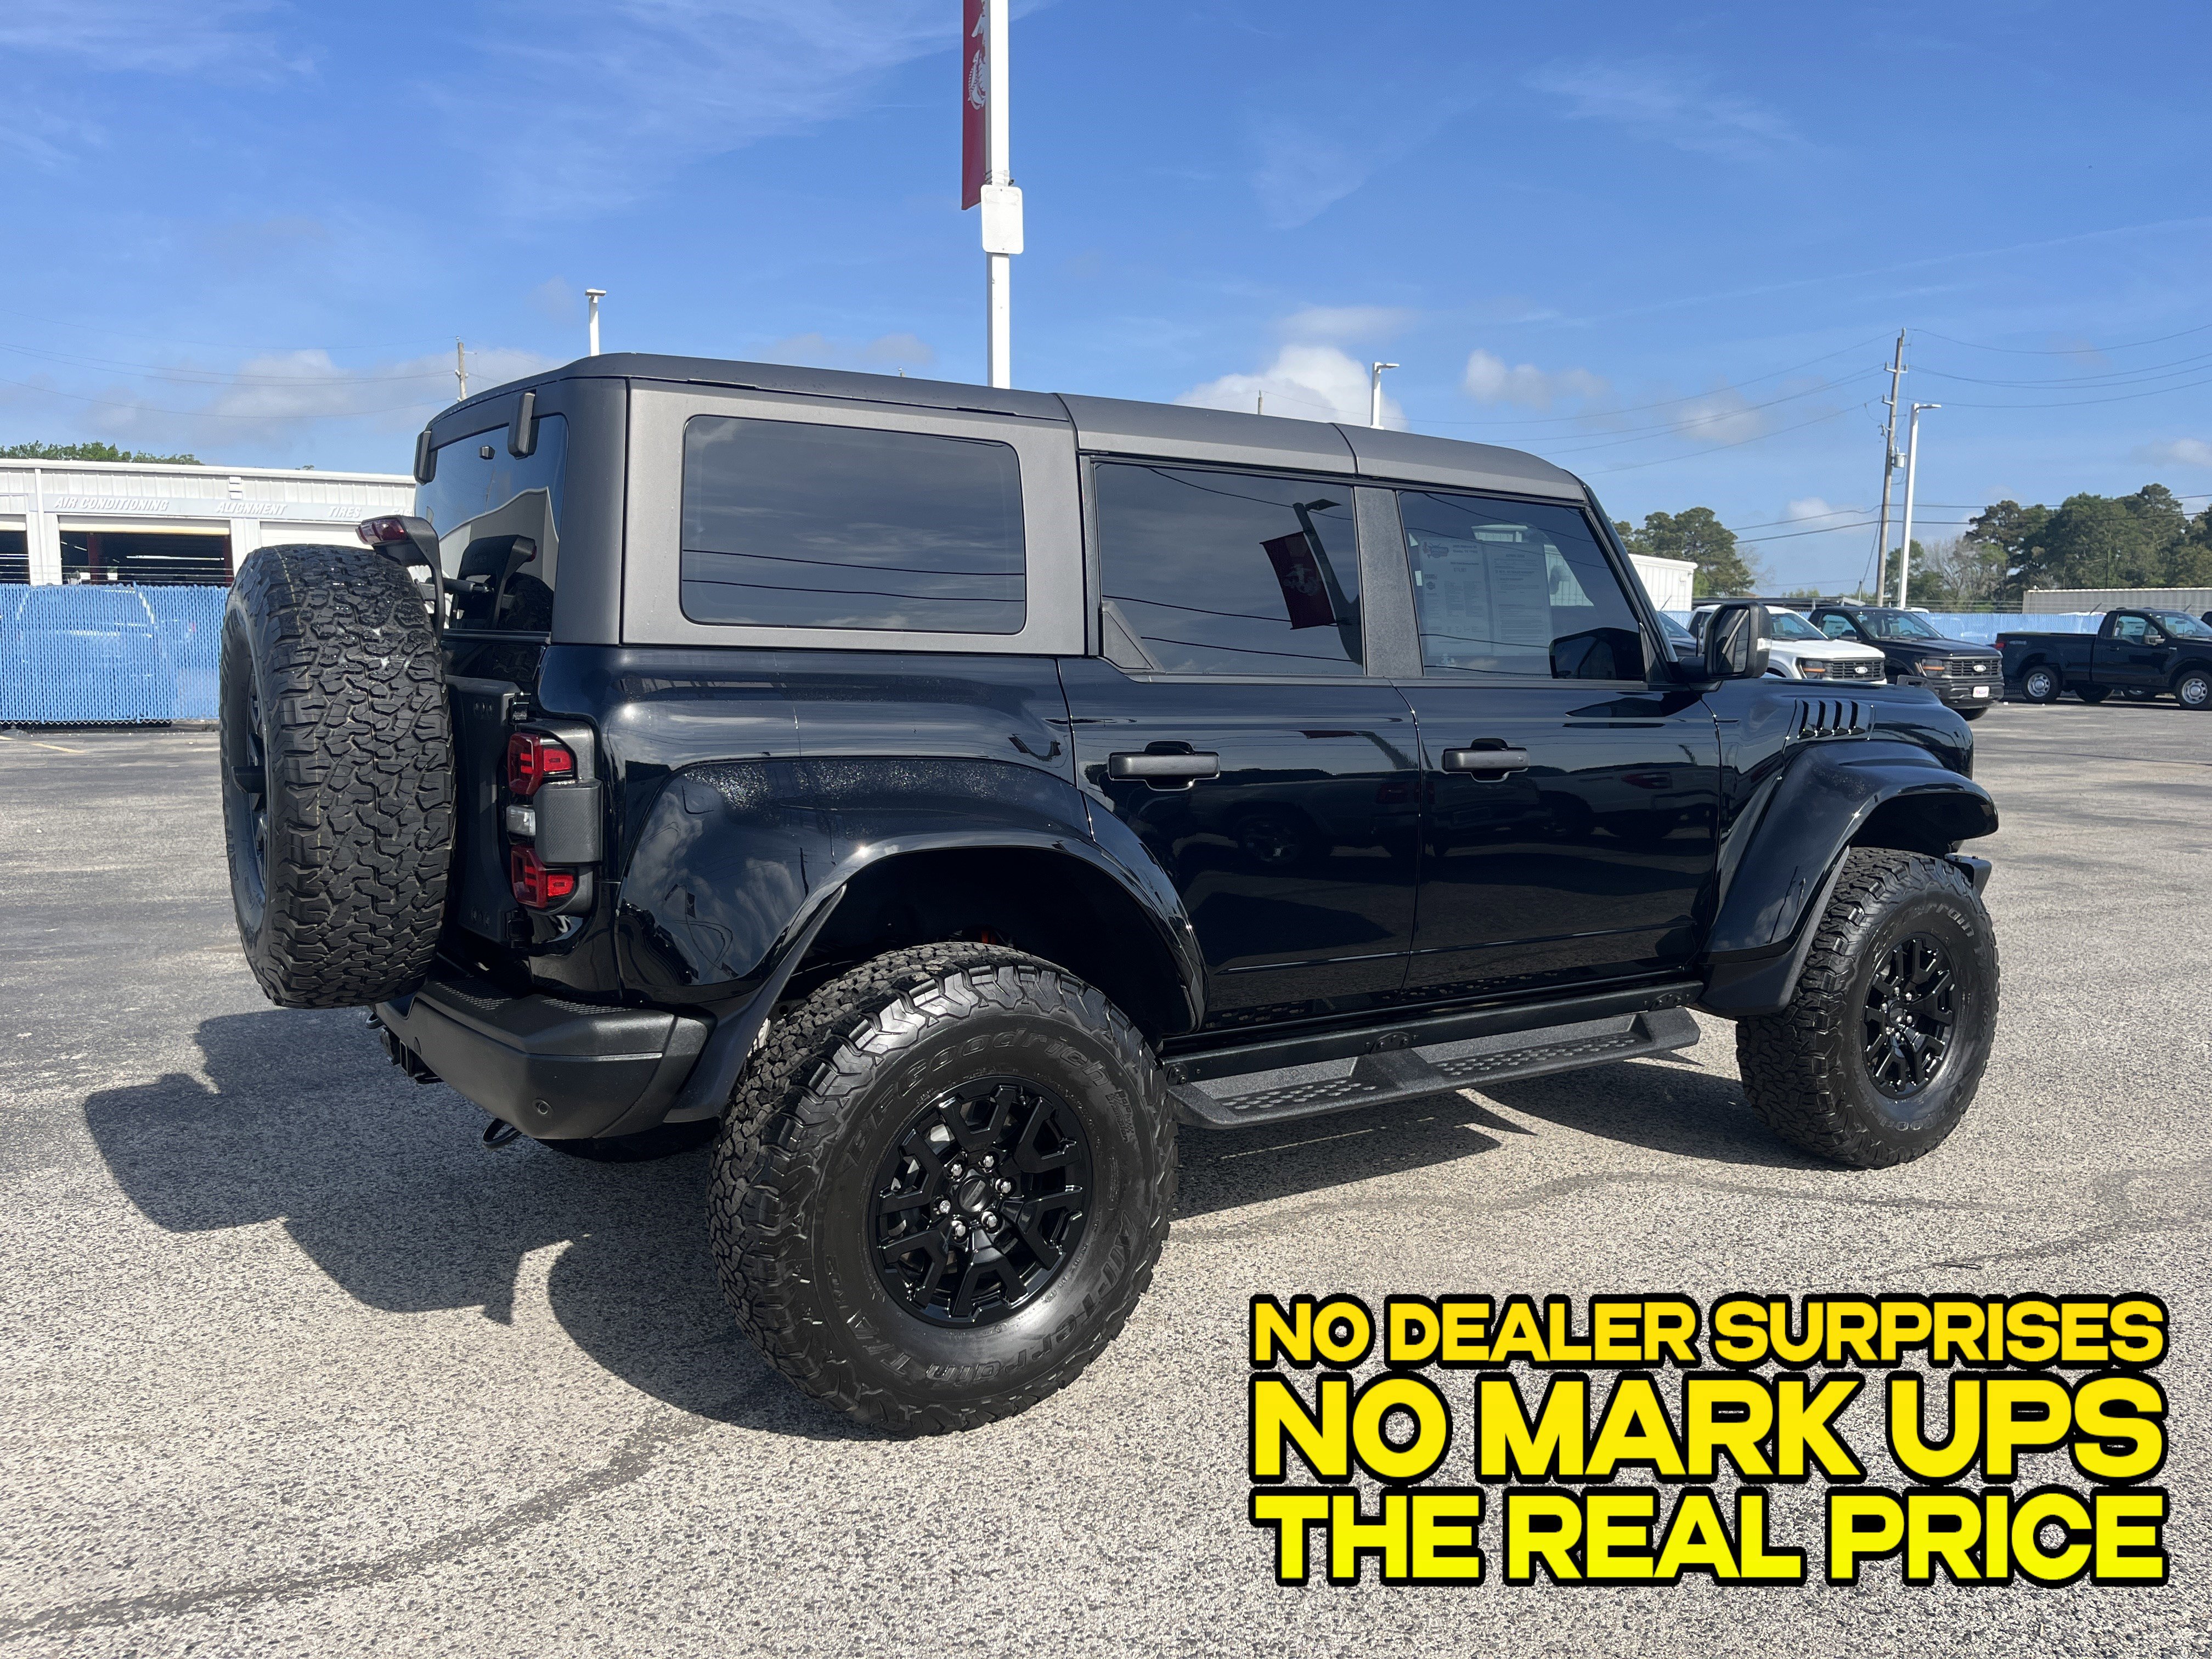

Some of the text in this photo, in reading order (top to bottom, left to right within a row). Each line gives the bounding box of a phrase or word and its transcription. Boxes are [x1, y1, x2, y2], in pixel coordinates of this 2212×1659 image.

[54, 496, 170, 511] AIR CONDITIONING
[215, 501, 288, 516] ALIGNMENT
[328, 505, 362, 518] TIRES
[926, 1211, 1137, 1384] All-Terrain
